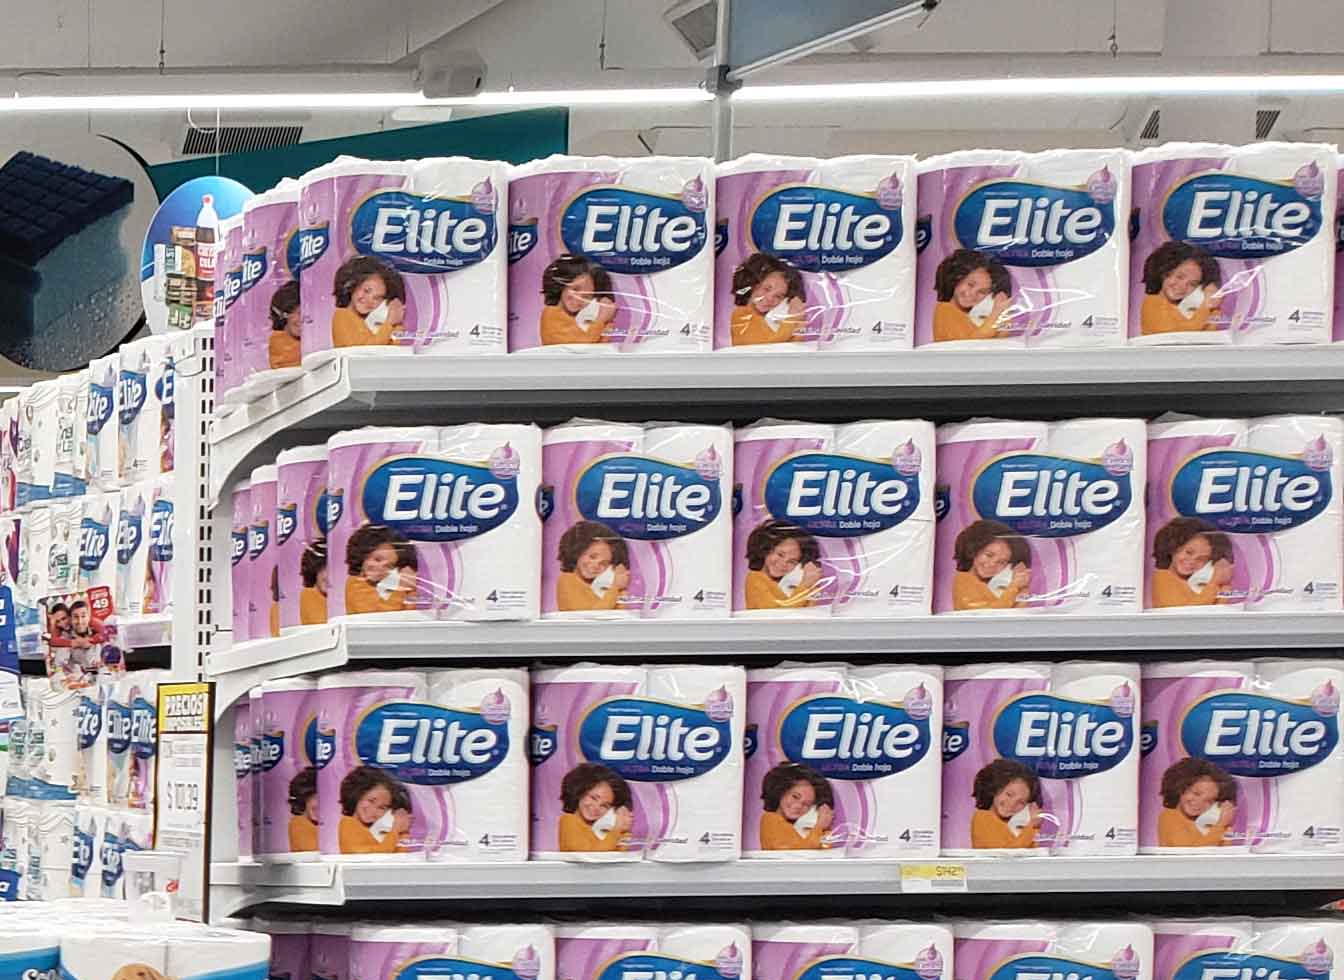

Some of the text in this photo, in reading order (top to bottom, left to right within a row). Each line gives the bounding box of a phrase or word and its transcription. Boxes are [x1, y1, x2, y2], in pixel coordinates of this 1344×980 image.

[372, 206, 487, 253] Elite
[583, 204, 696, 253] Elite
[773, 203, 891, 252] Elite
[977, 198, 1103, 246] Elite
[871, 321, 883, 335] 4
[383, 473, 507, 521] Elite
[1195, 465, 1320, 513] Elite
[889, 584, 900, 597] 4
[600, 715, 722, 763] Elite
[1204, 708, 1326, 757] Elite
